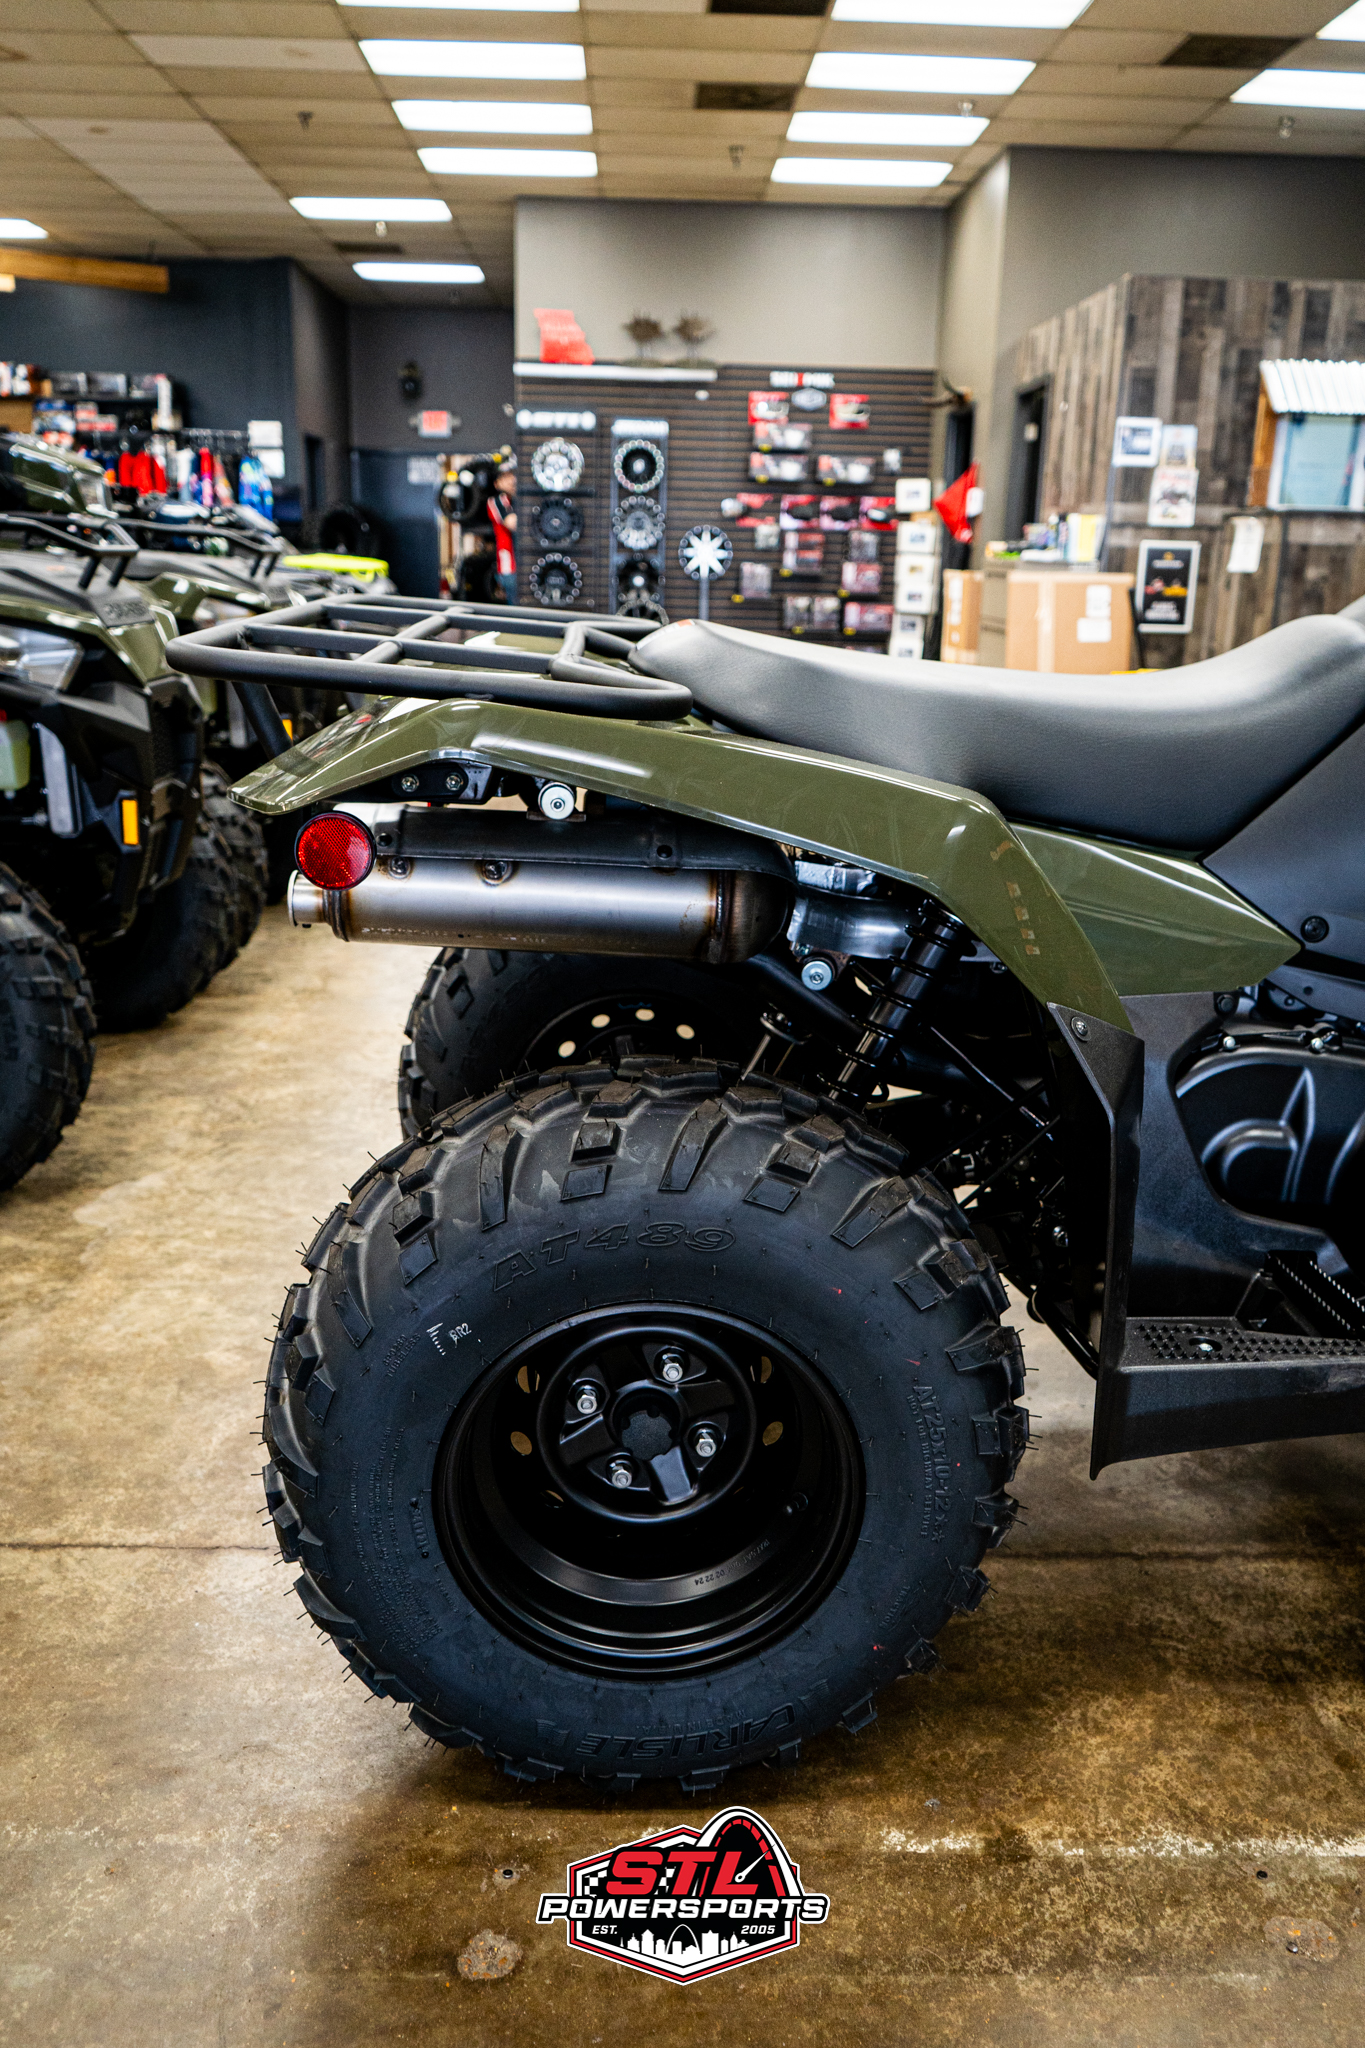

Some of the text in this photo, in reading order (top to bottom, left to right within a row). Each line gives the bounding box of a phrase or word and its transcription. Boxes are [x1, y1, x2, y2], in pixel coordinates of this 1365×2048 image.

[494, 1222, 735, 1291] AT489
[385, 1333, 421, 1378] TUBELESS
[906, 1395, 933, 1538] NOT FOR HIGHWAY SERVICE
[576, 1702, 797, 1760] CARLISLE
[686, 1719, 702, 1732] IN
[705, 1708, 747, 1729] MADE
